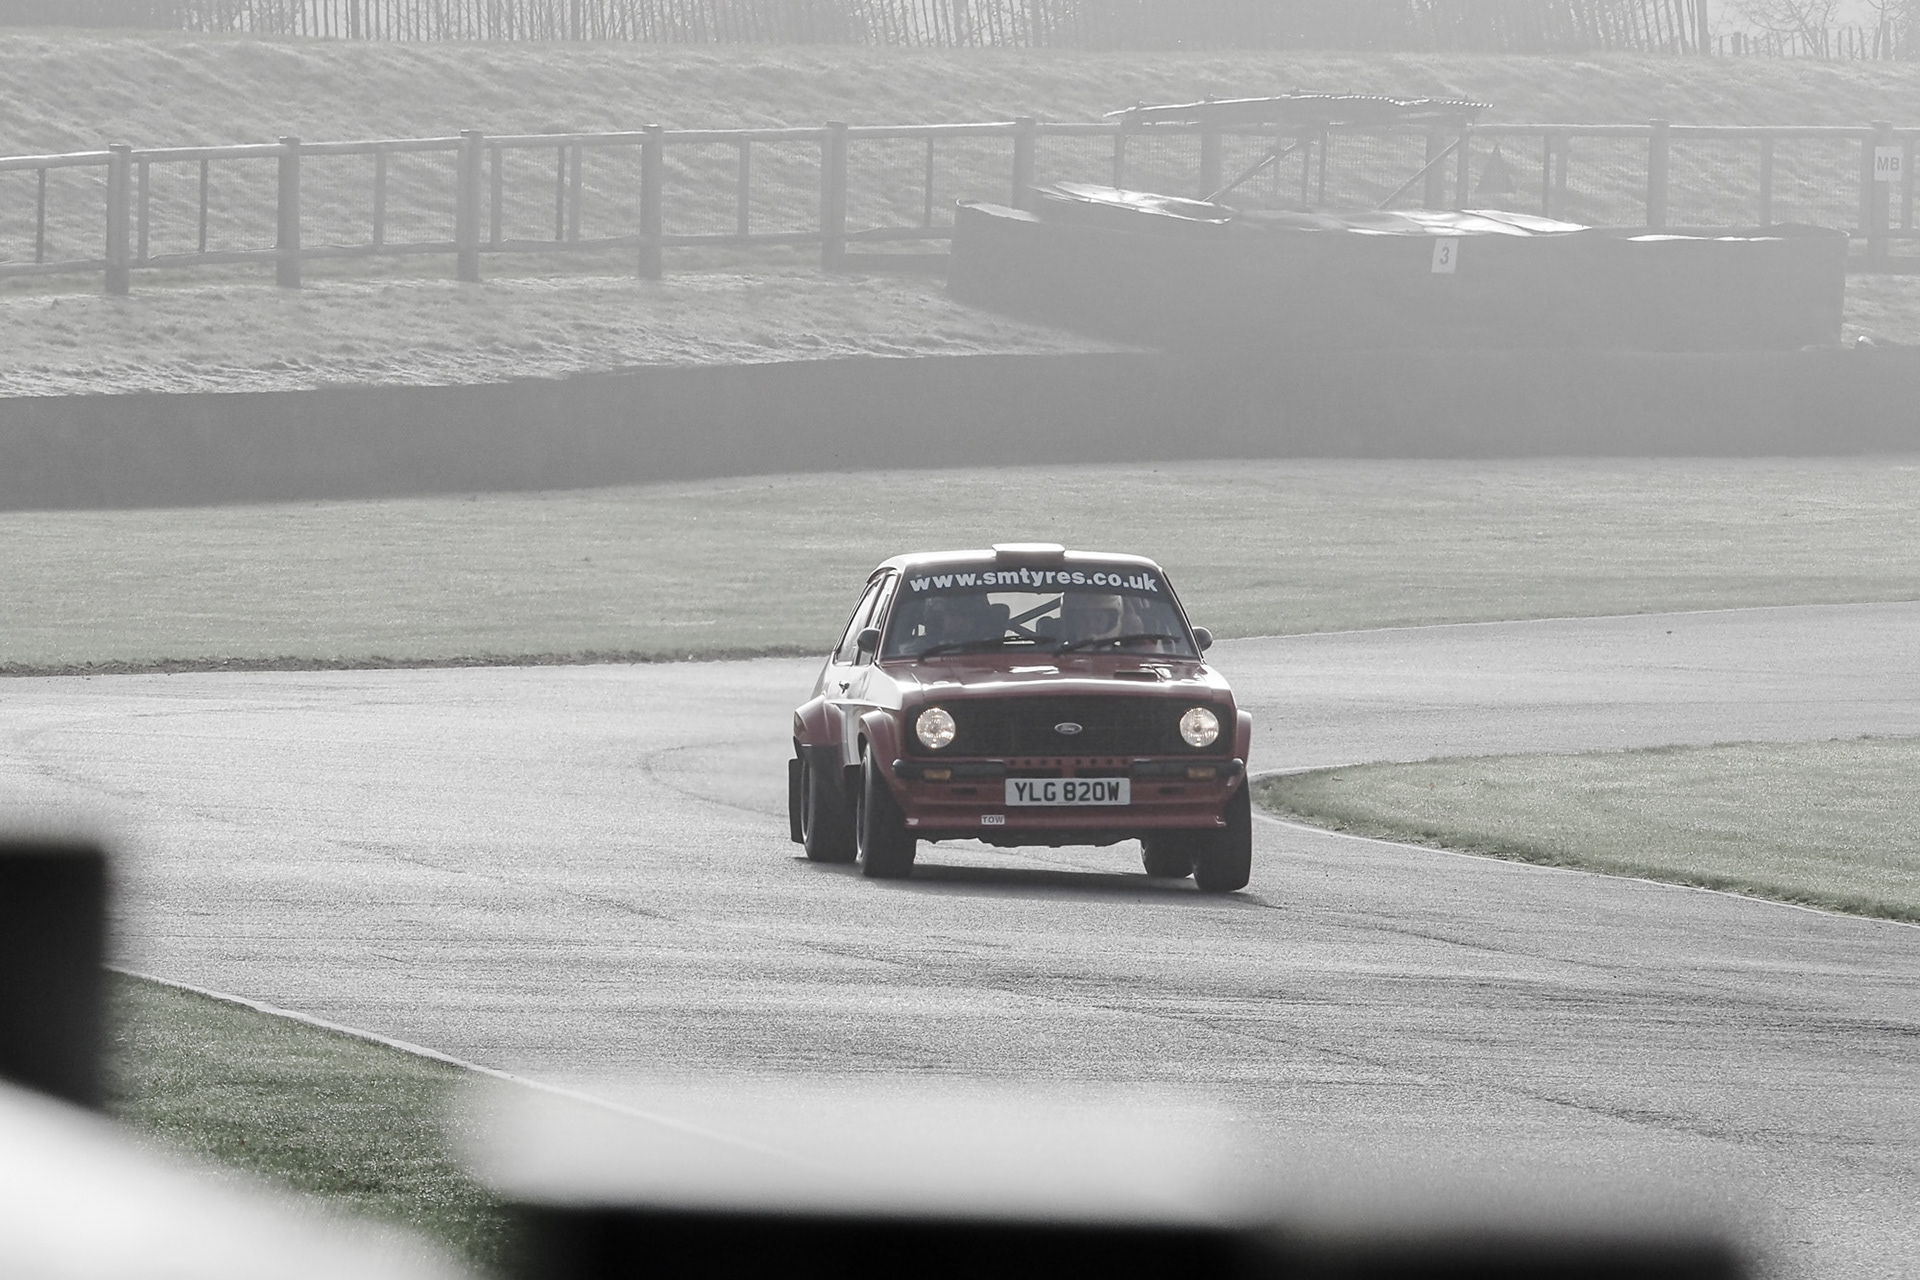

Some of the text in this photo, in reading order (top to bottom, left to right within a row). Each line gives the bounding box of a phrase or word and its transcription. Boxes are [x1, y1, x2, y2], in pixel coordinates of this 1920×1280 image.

[1440, 246, 1450, 265] 3
[910, 568, 1158, 592] www.smtyres.co.uk
[1014, 781, 1120, 802] YLG 820W
[982, 816, 1004, 824] TOW
